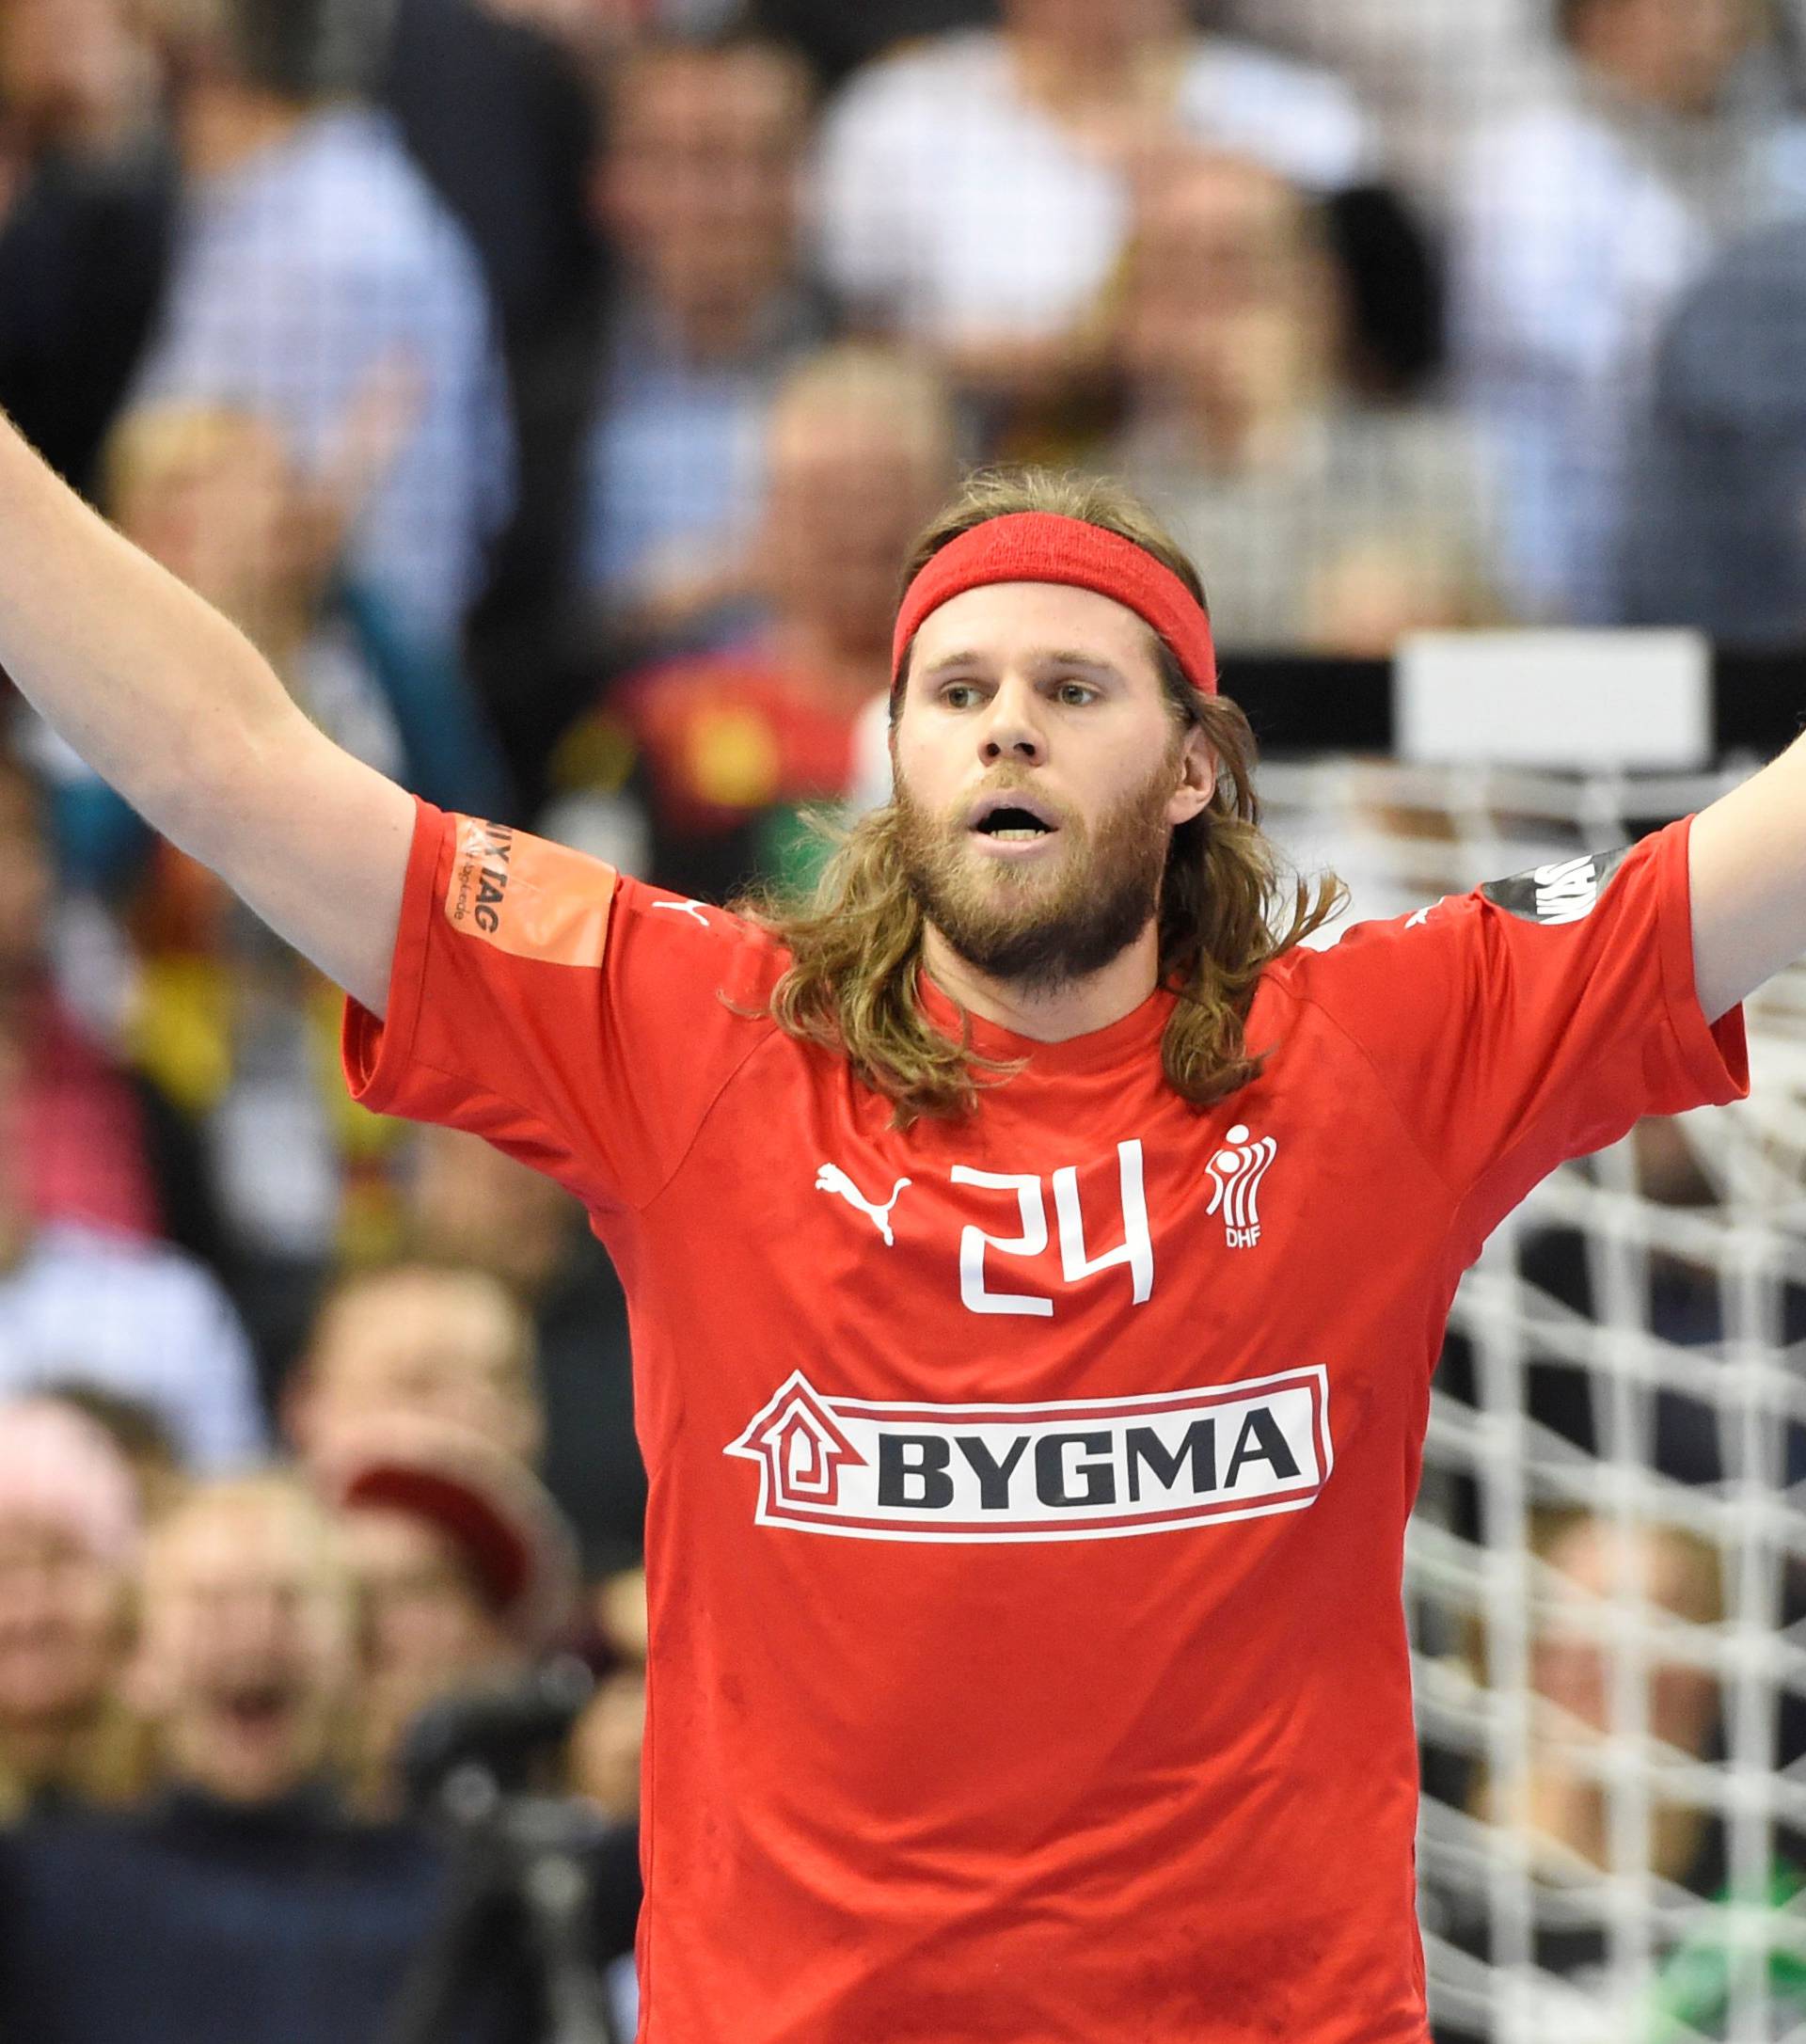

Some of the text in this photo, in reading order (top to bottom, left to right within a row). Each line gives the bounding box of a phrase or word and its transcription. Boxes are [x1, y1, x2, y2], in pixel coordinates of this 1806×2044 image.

[950, 1138, 1154, 1317] 24
[1225, 1225, 1261, 1249] DHF
[878, 1406, 1302, 1510] BYGMA
